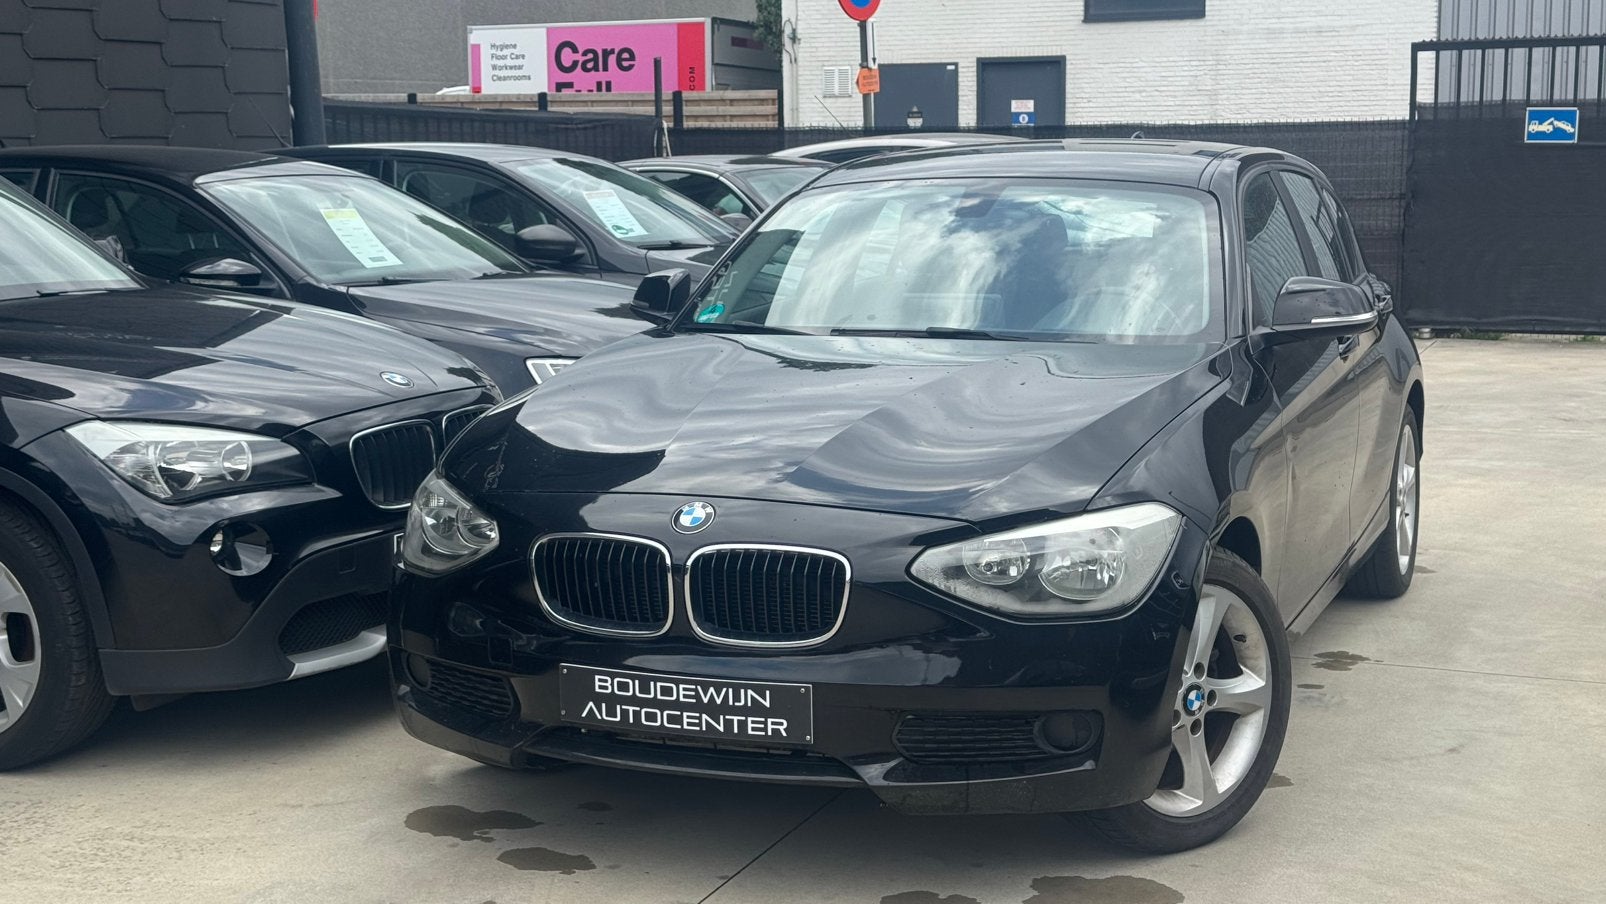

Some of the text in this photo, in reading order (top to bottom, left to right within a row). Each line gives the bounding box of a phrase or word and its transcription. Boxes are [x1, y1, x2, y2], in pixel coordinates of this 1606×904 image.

[490, 43, 517, 52] Hygiene
[510, 52, 526, 60] Care
[555, 40, 636, 74] Care
[491, 63, 525, 71] Workwear
[491, 74, 532, 82] Cleanrooms
[594, 675, 770, 708] BOUDEWIJN
[581, 701, 788, 737] AUTOCENTER
